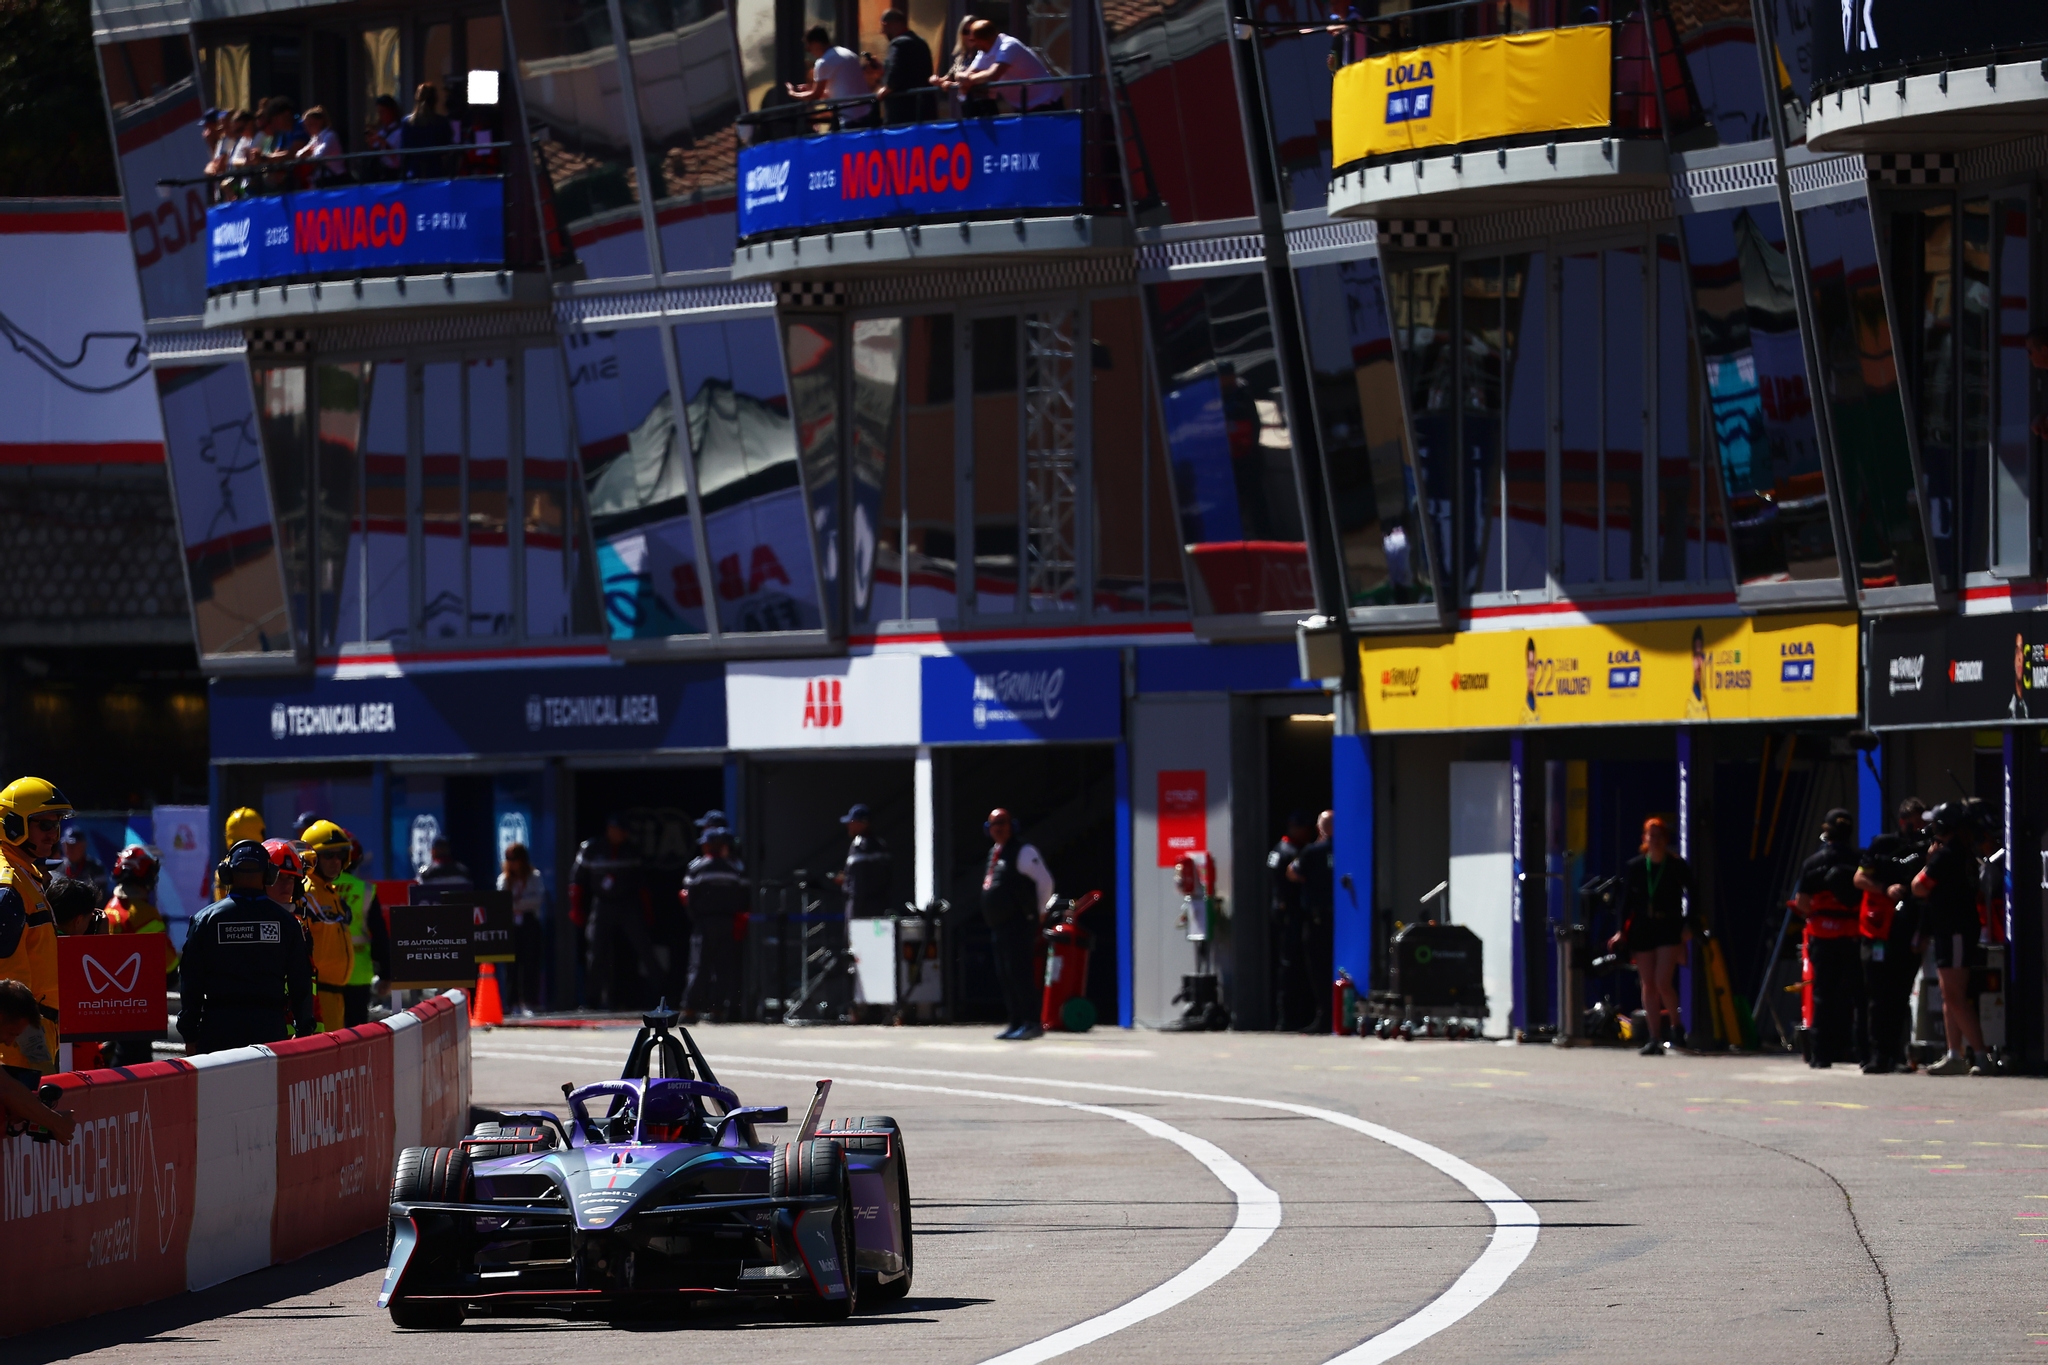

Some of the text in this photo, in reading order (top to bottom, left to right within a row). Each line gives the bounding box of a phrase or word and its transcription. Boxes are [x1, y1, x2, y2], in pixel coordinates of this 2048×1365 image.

[1385, 60, 1434, 87] LOLA
[841, 141, 973, 200] MONACO
[982, 152, 1041, 174] E-PRIX
[294, 201, 408, 256] MONACO
[416, 211, 468, 231] E-PRIX
[1608, 650, 1642, 664] LOLA
[1781, 641, 1815, 656] LOLA
[1535, 658, 1554, 697] 22
[545, 696, 620, 727] TECHNICAL
[620, 694, 660, 726] AREA
[803, 679, 843, 728] ABB
[287, 703, 360, 736] TECHNICAL
[359, 702, 397, 734] AREA
[474, 930, 508, 941] RETTI
[406, 952, 459, 960] PENSKE
[78, 997, 148, 1009] mahindra
[667, 1082, 692, 1090] LOCTITE
[578, 1191, 620, 1199] Mobil
